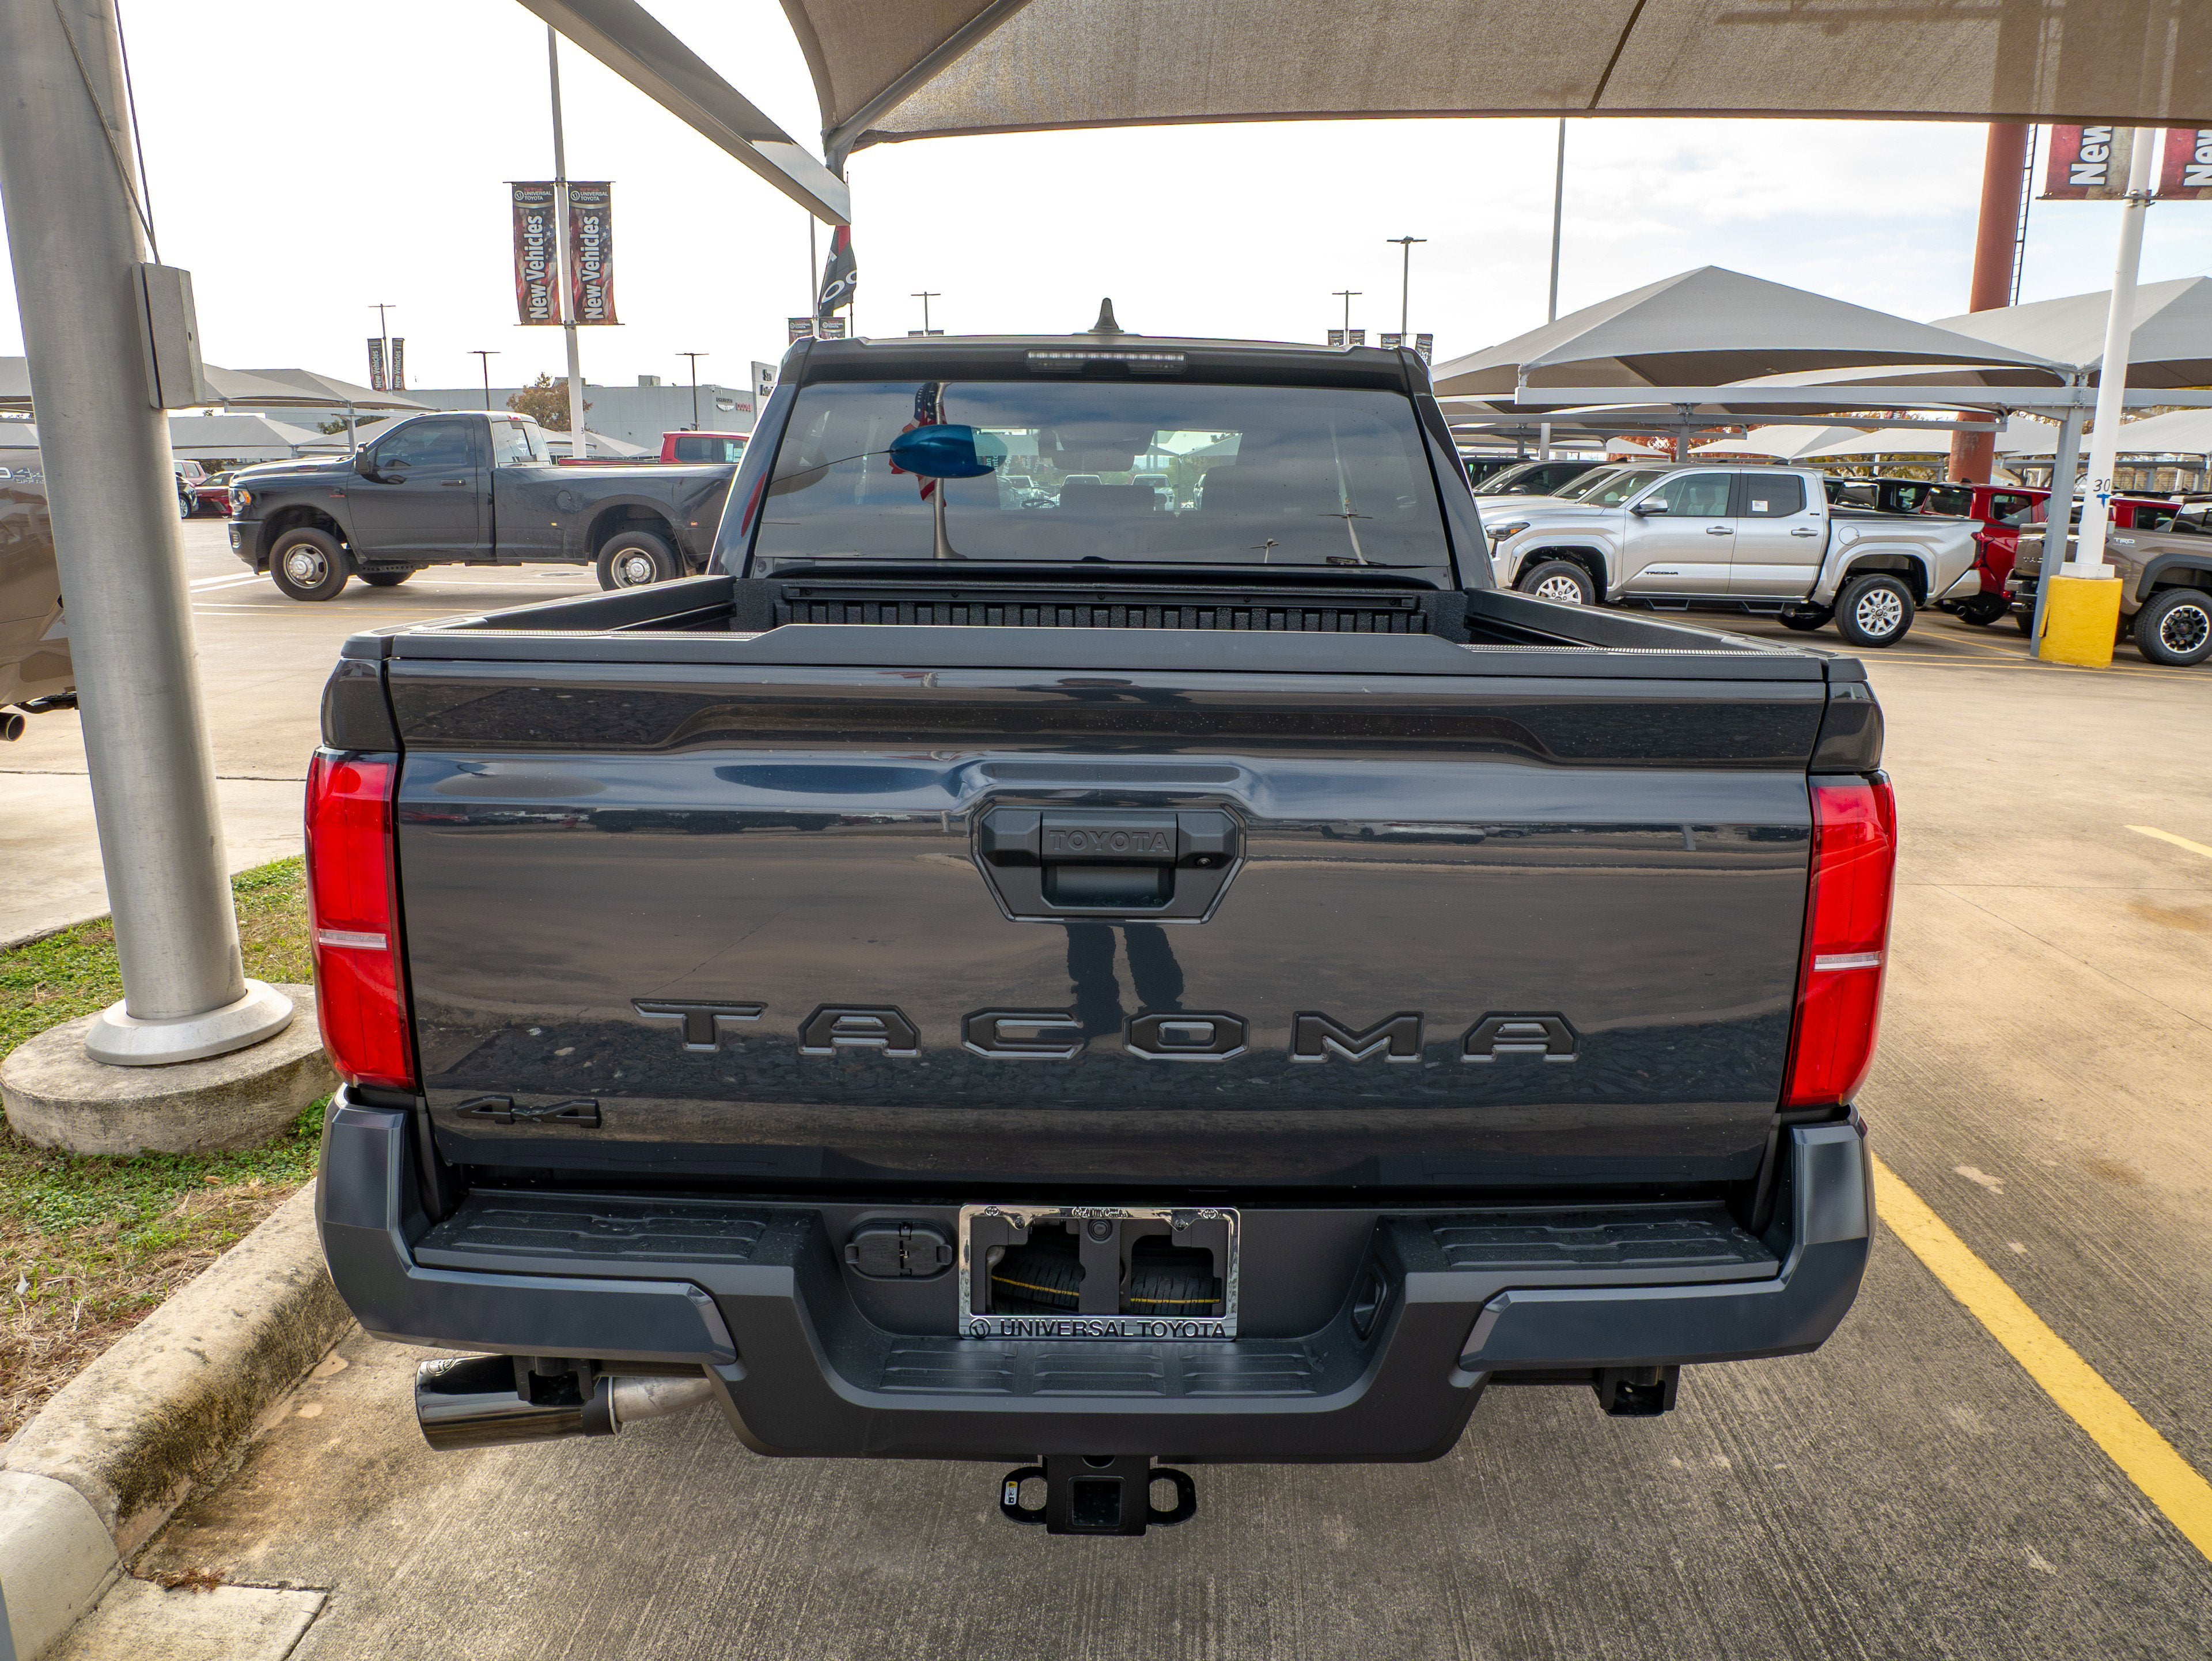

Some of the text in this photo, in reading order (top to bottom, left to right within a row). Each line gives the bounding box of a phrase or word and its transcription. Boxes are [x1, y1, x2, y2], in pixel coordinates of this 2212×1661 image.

[524, 215, 546, 282] Vehicles
[579, 215, 602, 282] Vehicles
[529, 284, 550, 319] New
[585, 285, 604, 320] New
[372, 350, 382, 388] New Vehicles
[394, 350, 402, 388] New Vehicles
[2093, 478, 2111, 492] 30
[1048, 829, 1171, 853] TOYOTA
[631, 998, 1579, 1064] TACOMA
[1000, 1318, 1134, 1338] UNIVERSAL
[1137, 1320, 1227, 1339] TOYOTA
